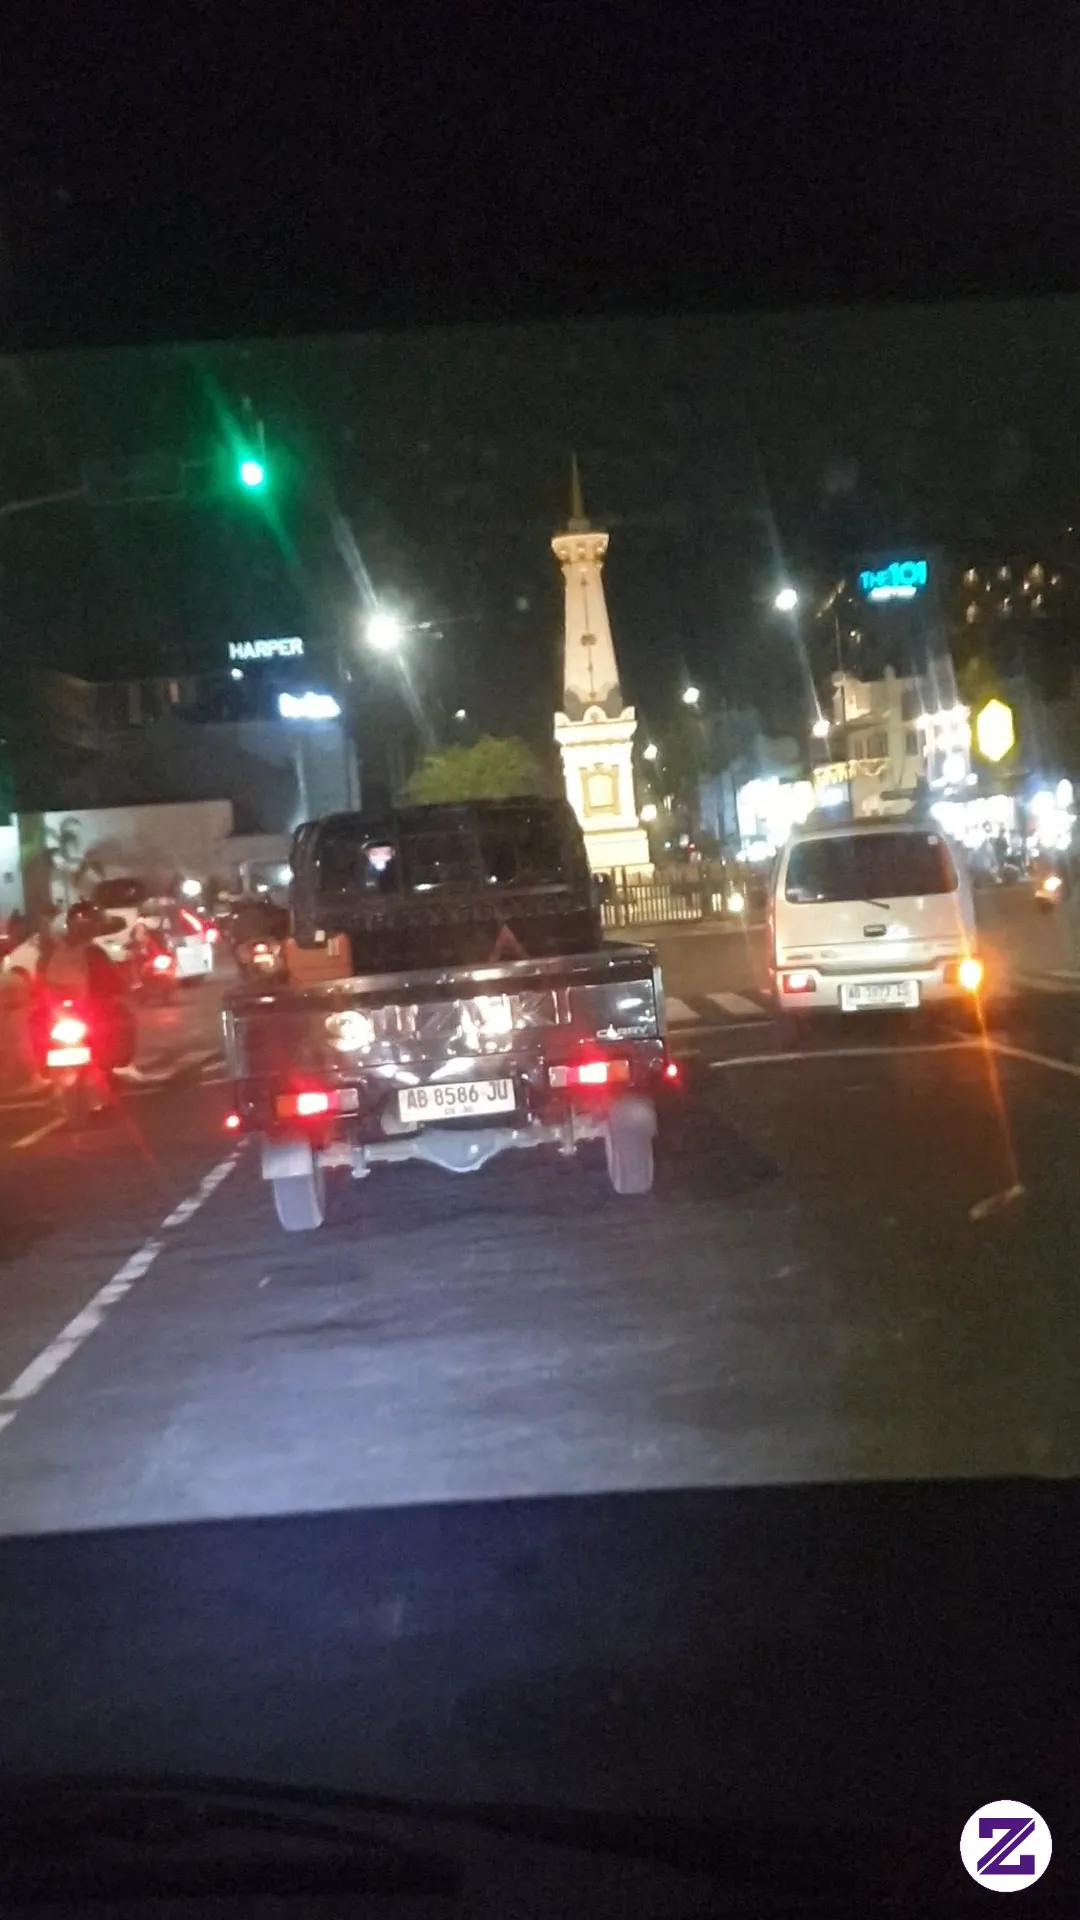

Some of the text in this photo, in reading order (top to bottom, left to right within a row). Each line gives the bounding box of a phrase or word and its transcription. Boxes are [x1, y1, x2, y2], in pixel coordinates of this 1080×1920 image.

[889, 561, 927, 586] 101
[228, 637, 304, 660] HARPER
[407, 1080, 508, 1109] AB 8586 JU
